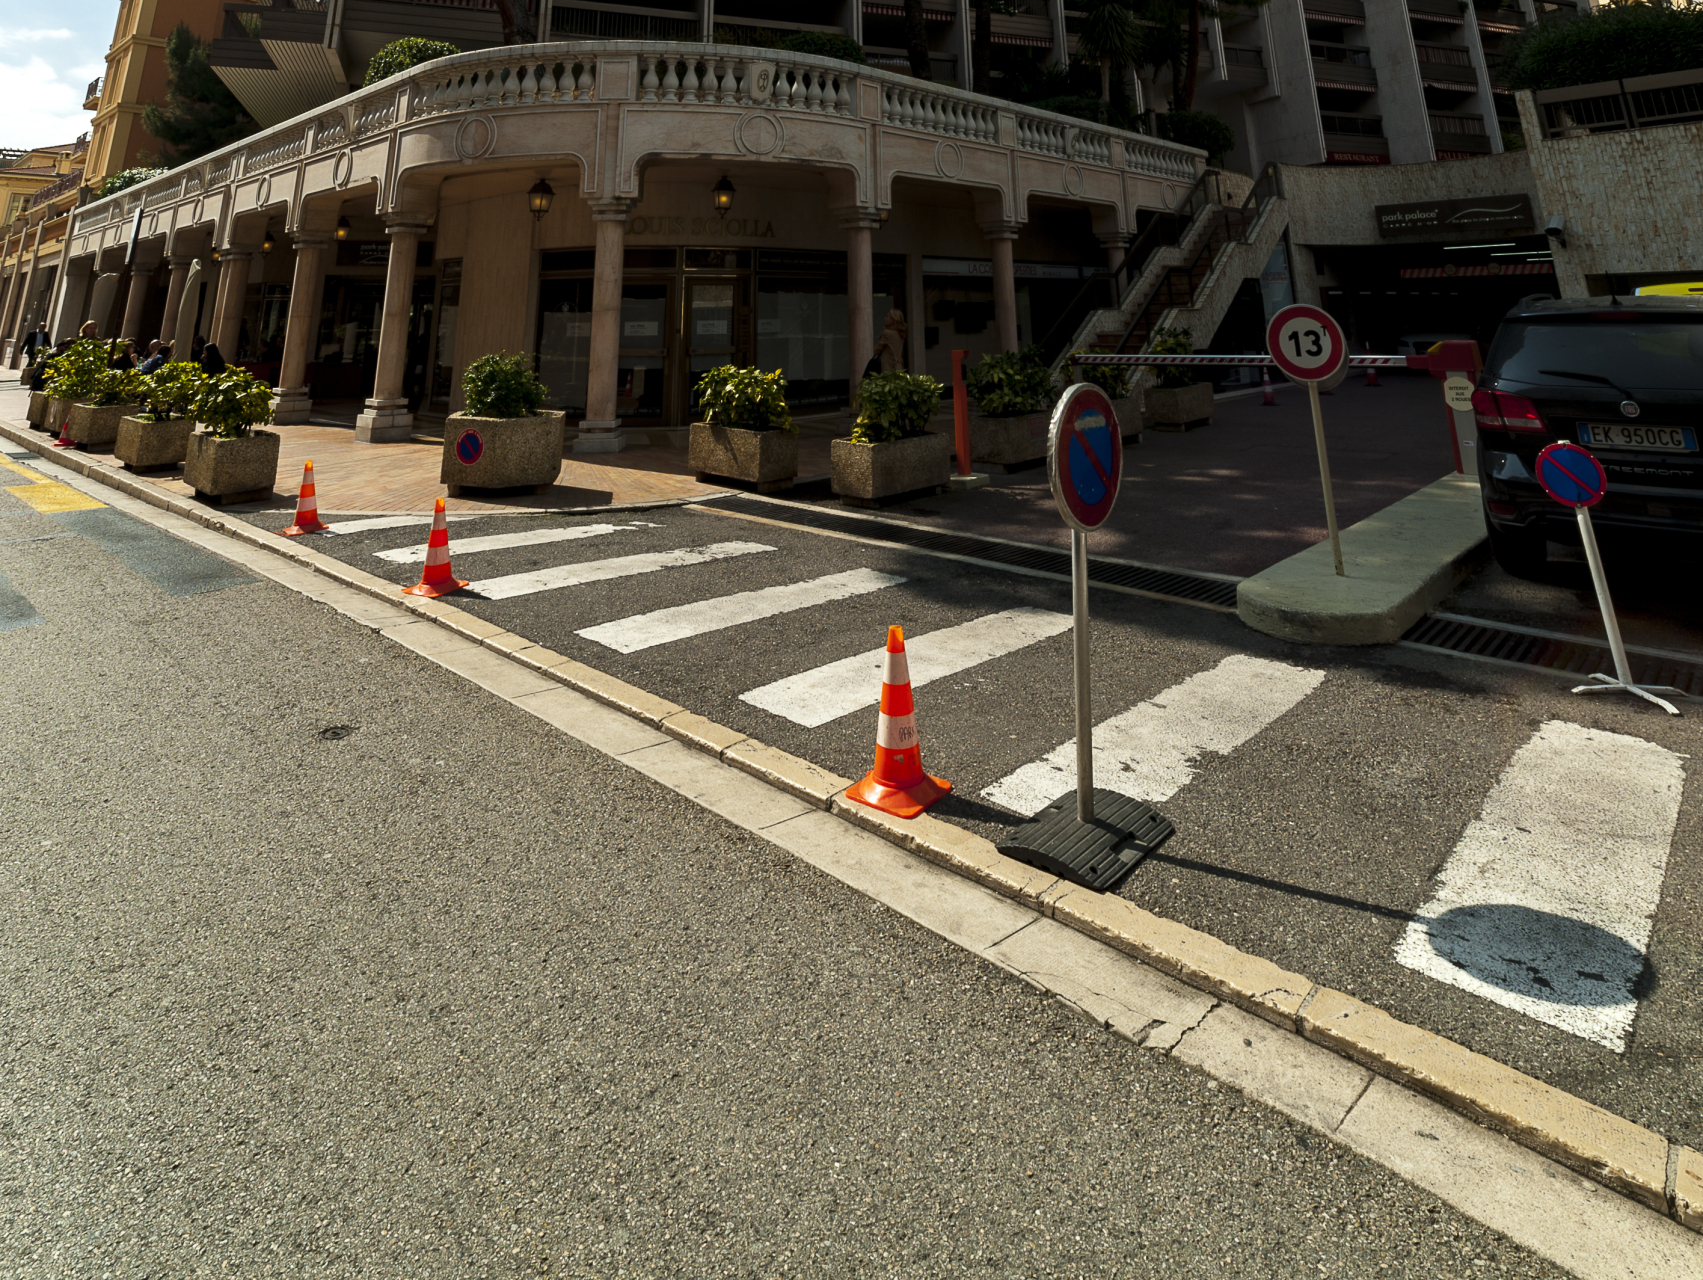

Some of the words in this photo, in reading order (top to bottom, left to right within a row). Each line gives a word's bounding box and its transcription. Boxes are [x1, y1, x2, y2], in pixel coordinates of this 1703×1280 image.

[1334, 152, 1379, 162] RESTAURANT
[1382, 211, 1403, 223] park
[1405, 210, 1437, 222] palace
[691, 218, 776, 238] SCIOLLA
[968, 263, 978, 274] LA
[1013, 265, 1038, 276] OPERTIES
[1288, 330, 1323, 358] 13
[1591, 426, 1615, 444] EK
[1621, 428, 1682, 447] 950CG
